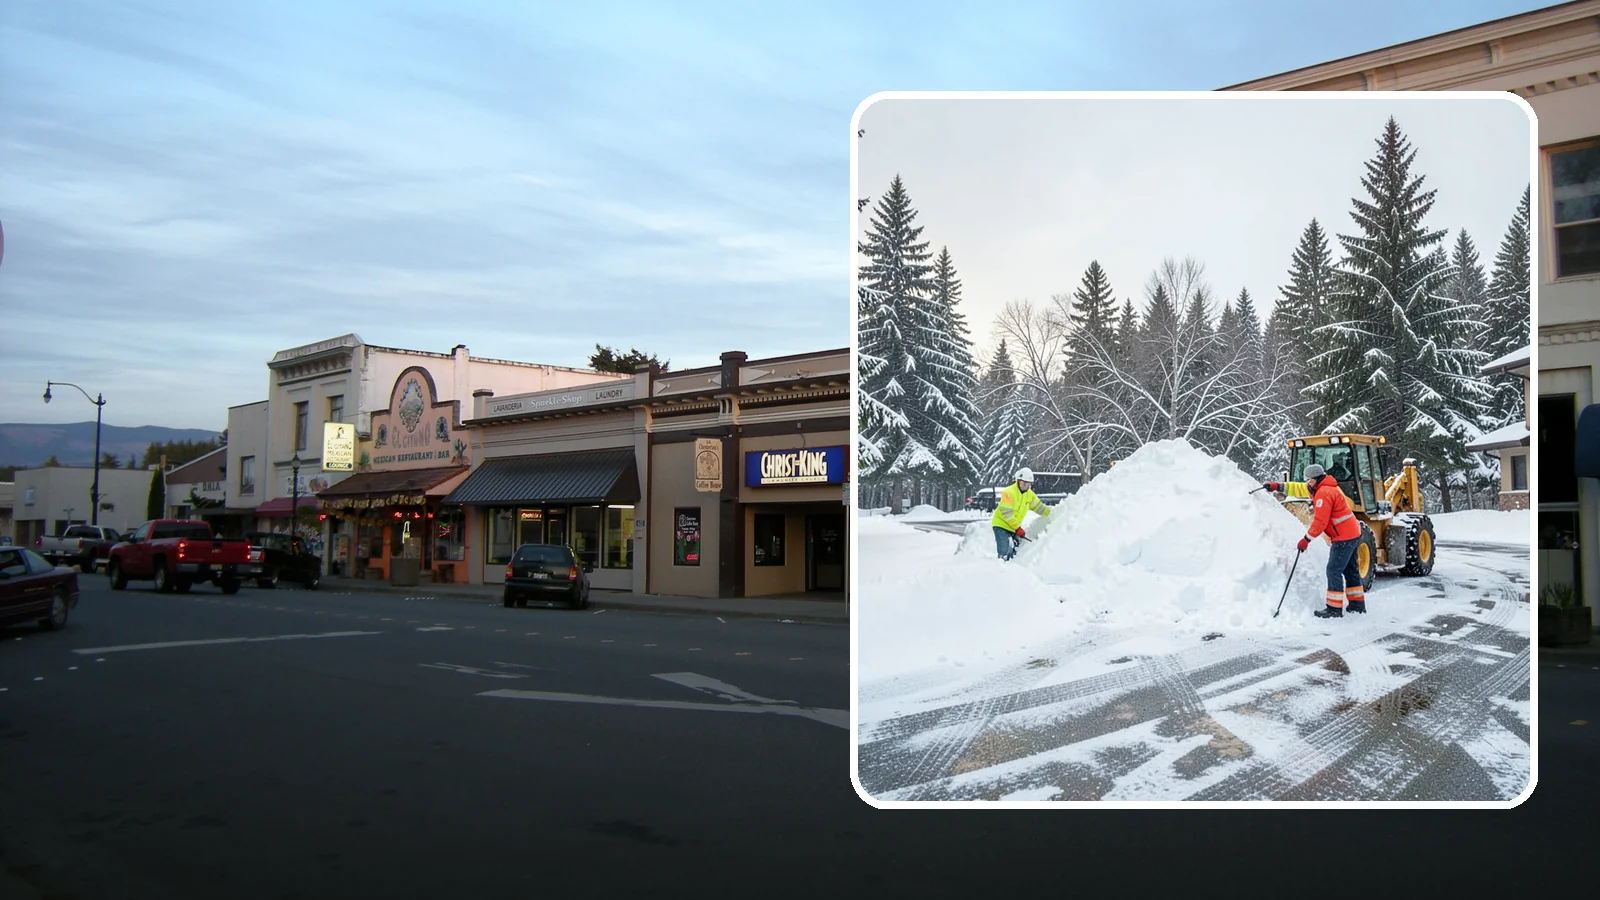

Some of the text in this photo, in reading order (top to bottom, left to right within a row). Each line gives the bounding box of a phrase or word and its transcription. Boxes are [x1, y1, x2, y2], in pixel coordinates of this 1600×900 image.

[595, 389, 623, 400] LAUNDRY
[493, 402, 523, 413] LAVANDERIA
[373, 455, 396, 464] MEXICAN
[397, 451, 433, 463] RESTAURANT
[438, 450, 450, 459] BAR
[760, 450, 827, 478] CHRIST KING
[697, 481, 722, 489] Coffee House
